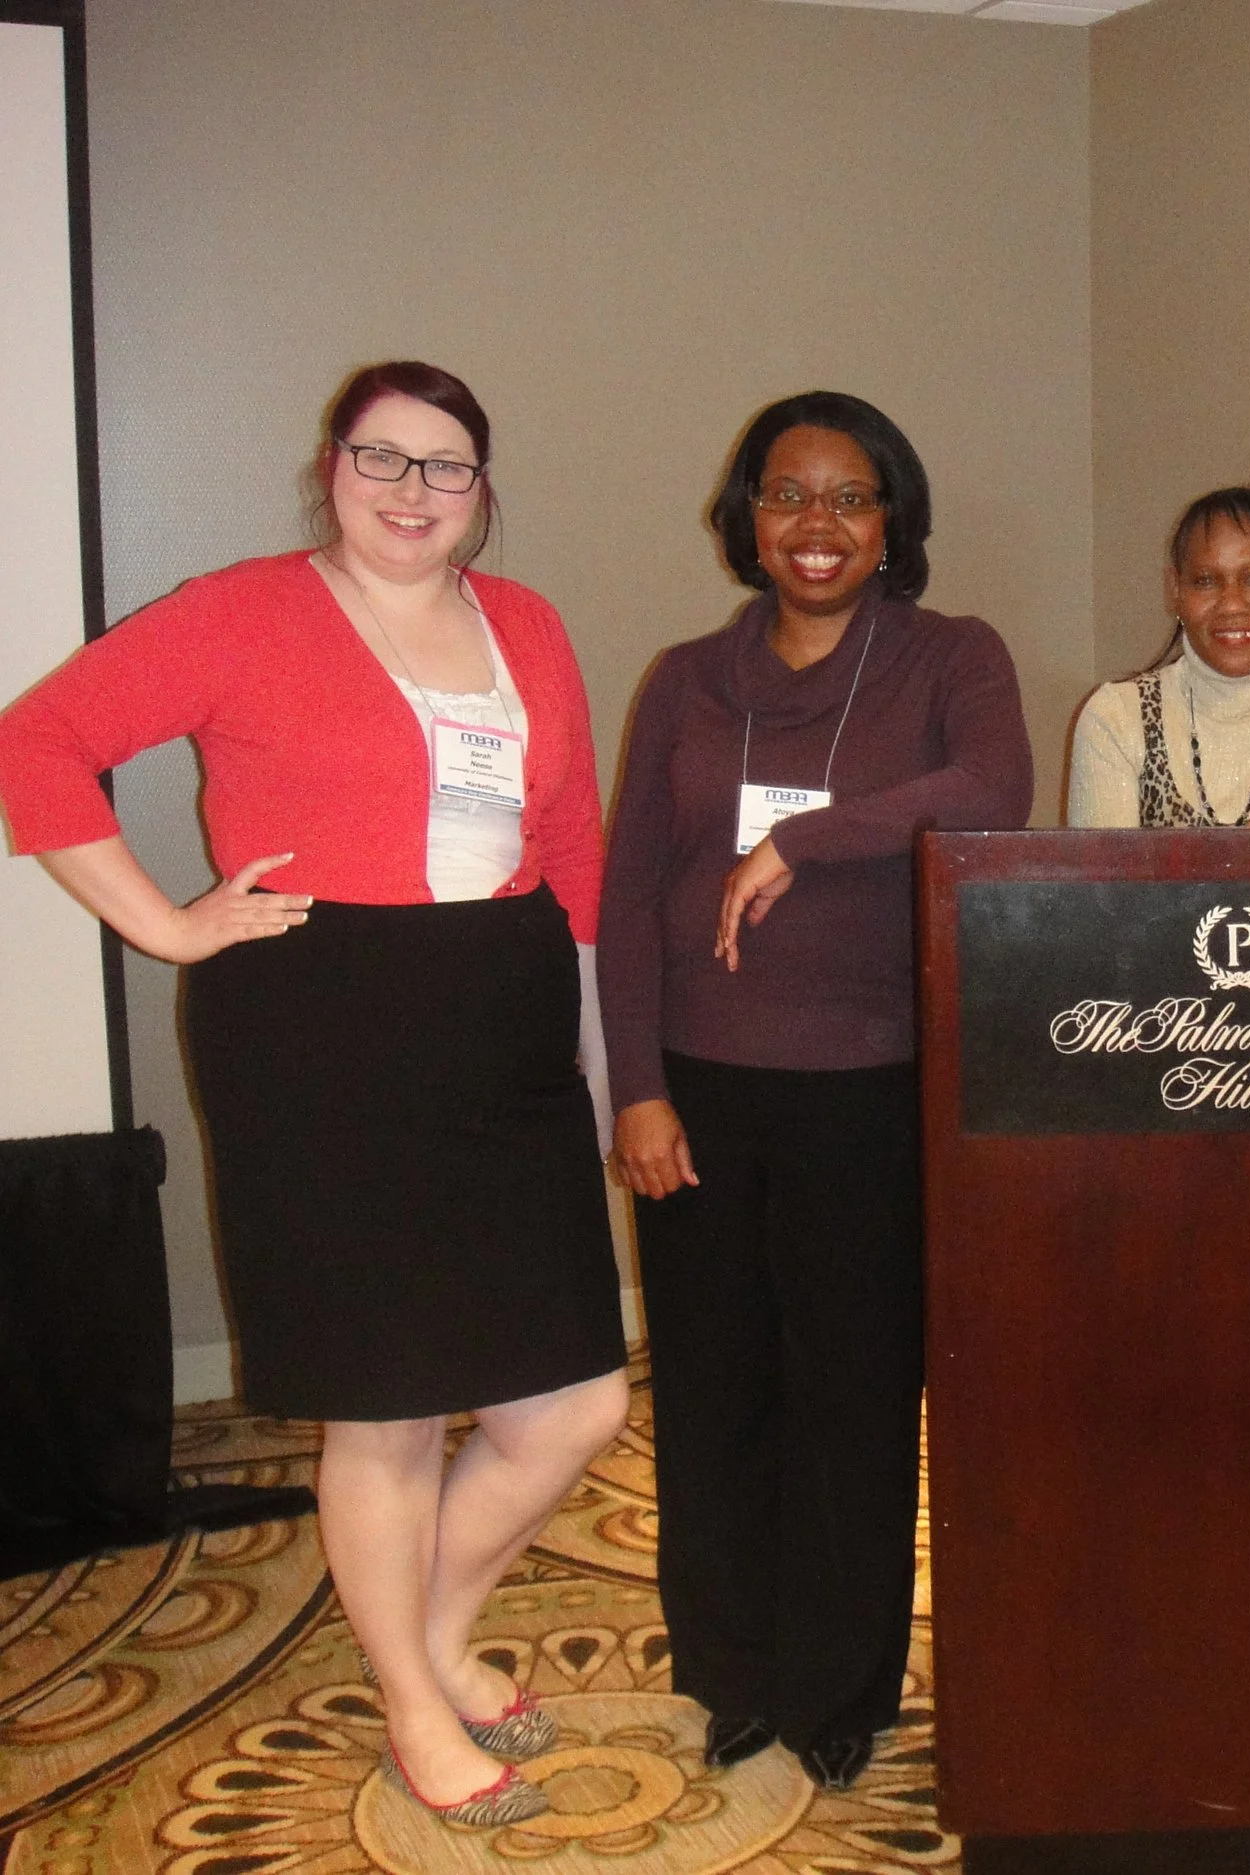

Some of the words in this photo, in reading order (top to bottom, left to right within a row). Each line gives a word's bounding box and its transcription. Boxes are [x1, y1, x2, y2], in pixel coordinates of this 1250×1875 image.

[470, 750, 492, 760] Sarah
[464, 780, 499, 793] Marketing
[1050, 999, 1141, 1054] The
